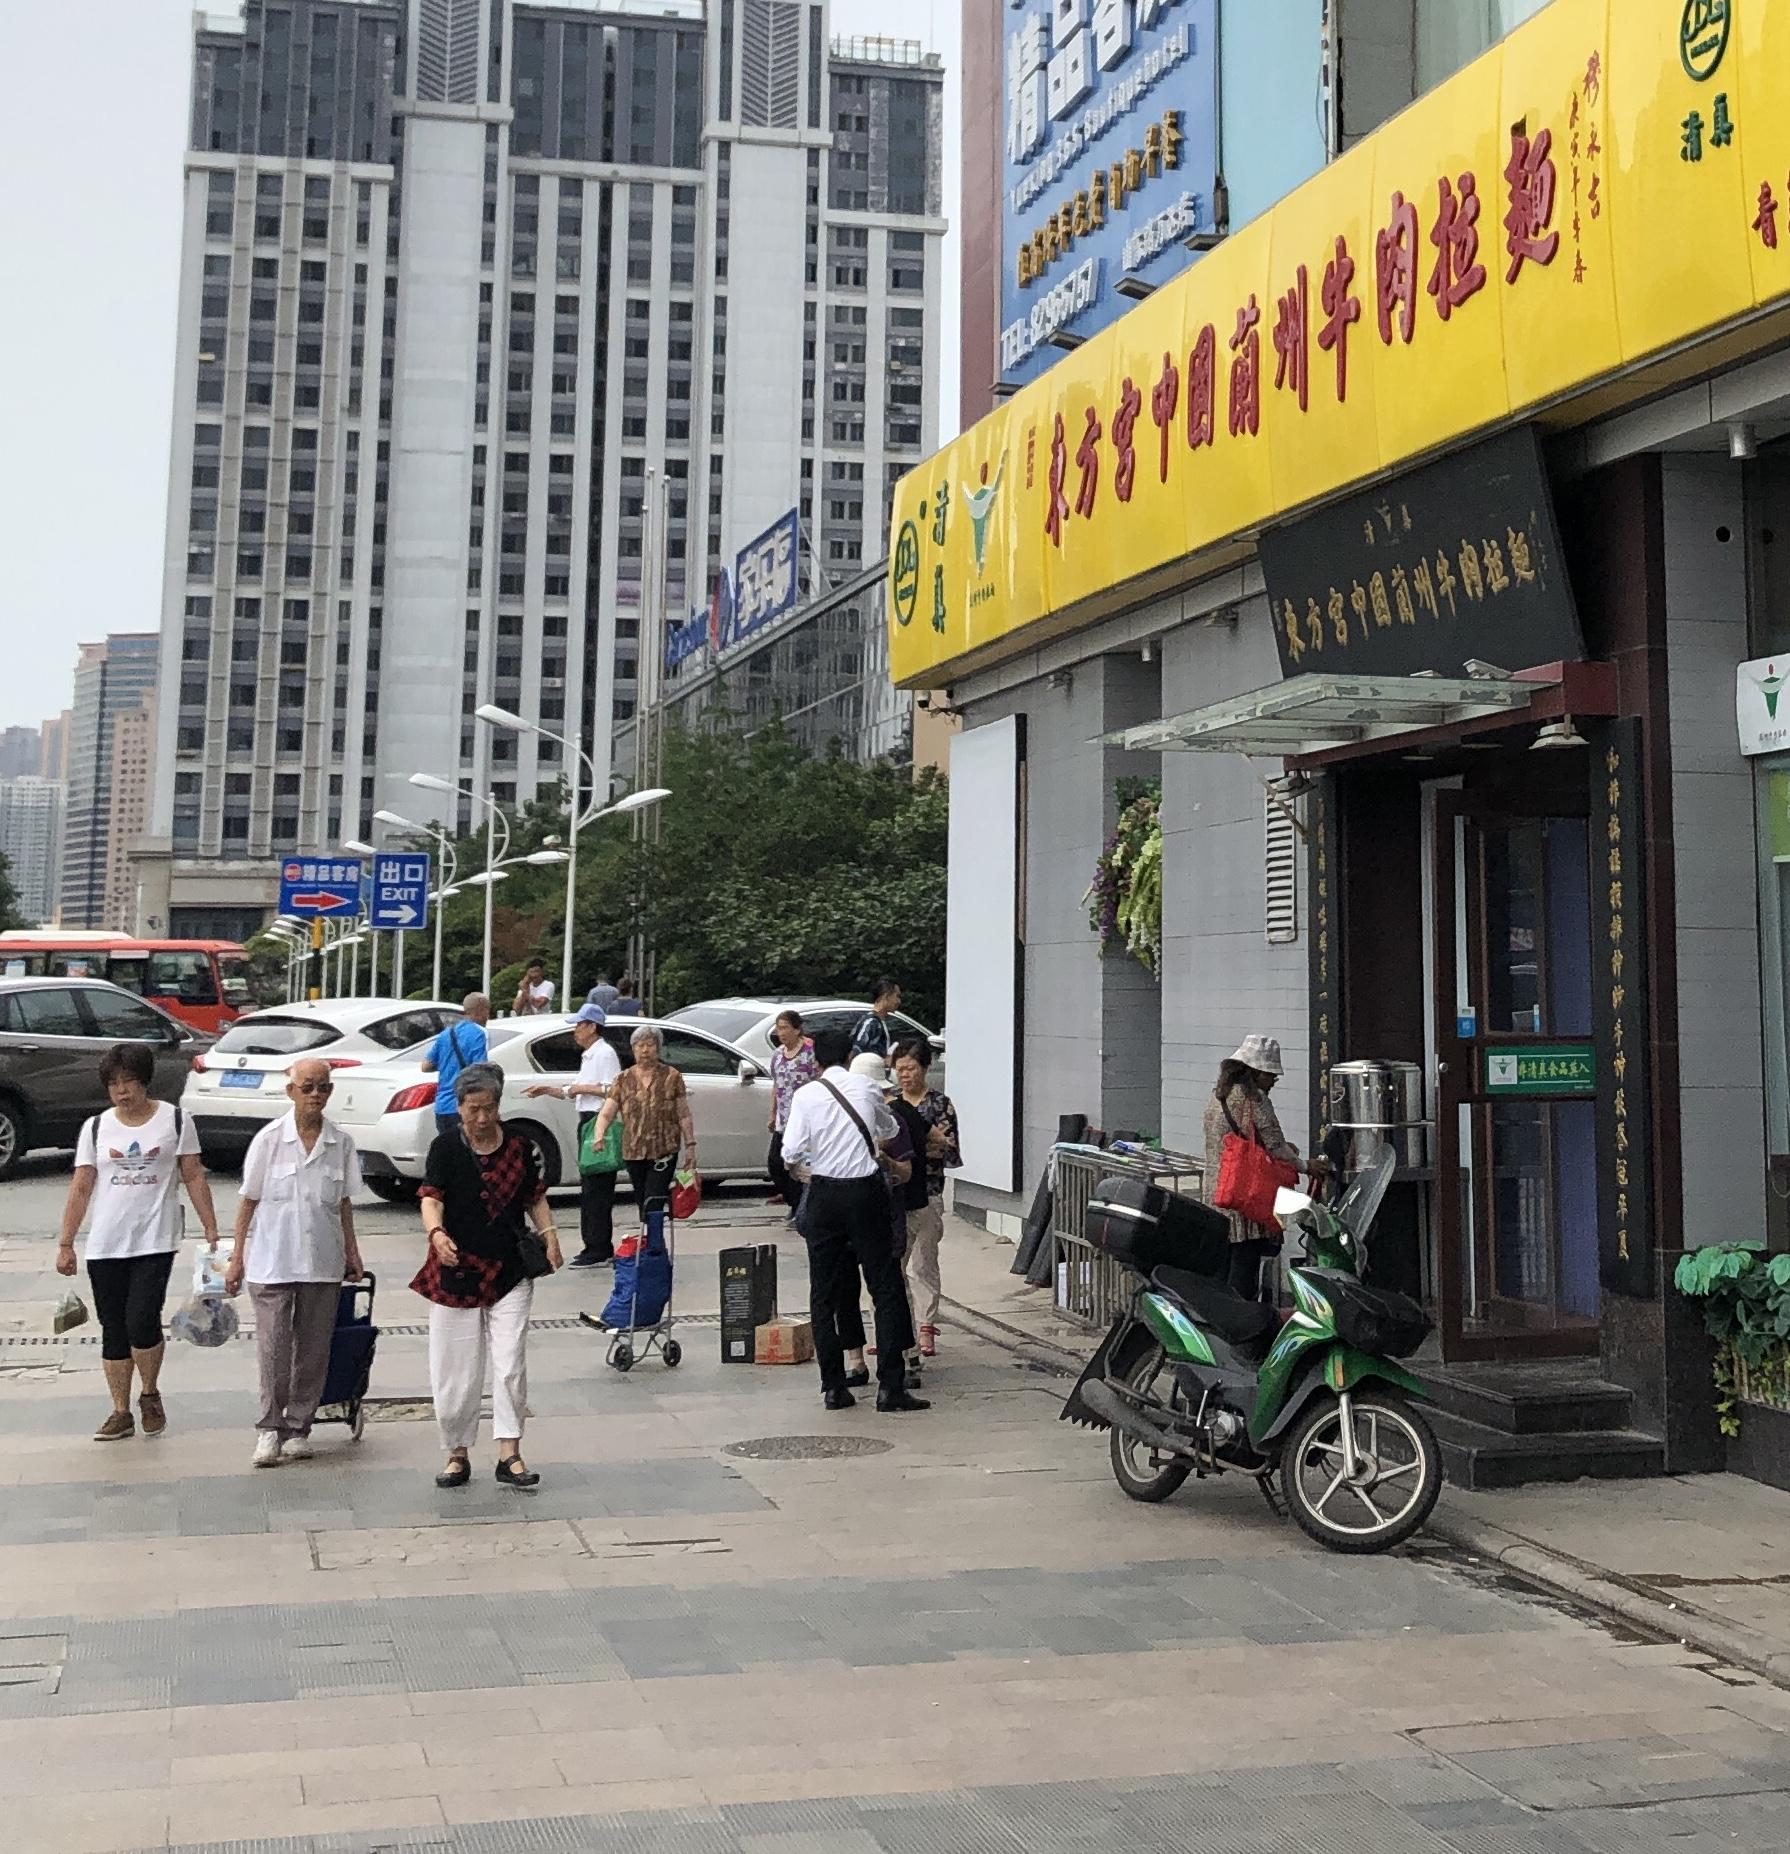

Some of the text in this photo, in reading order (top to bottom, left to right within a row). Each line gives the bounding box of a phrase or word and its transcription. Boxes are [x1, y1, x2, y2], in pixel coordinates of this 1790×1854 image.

[379, 860, 424, 883] 出口
[381, 887, 419, 901] EXIT
[110, 1173, 158, 1186] adidas
